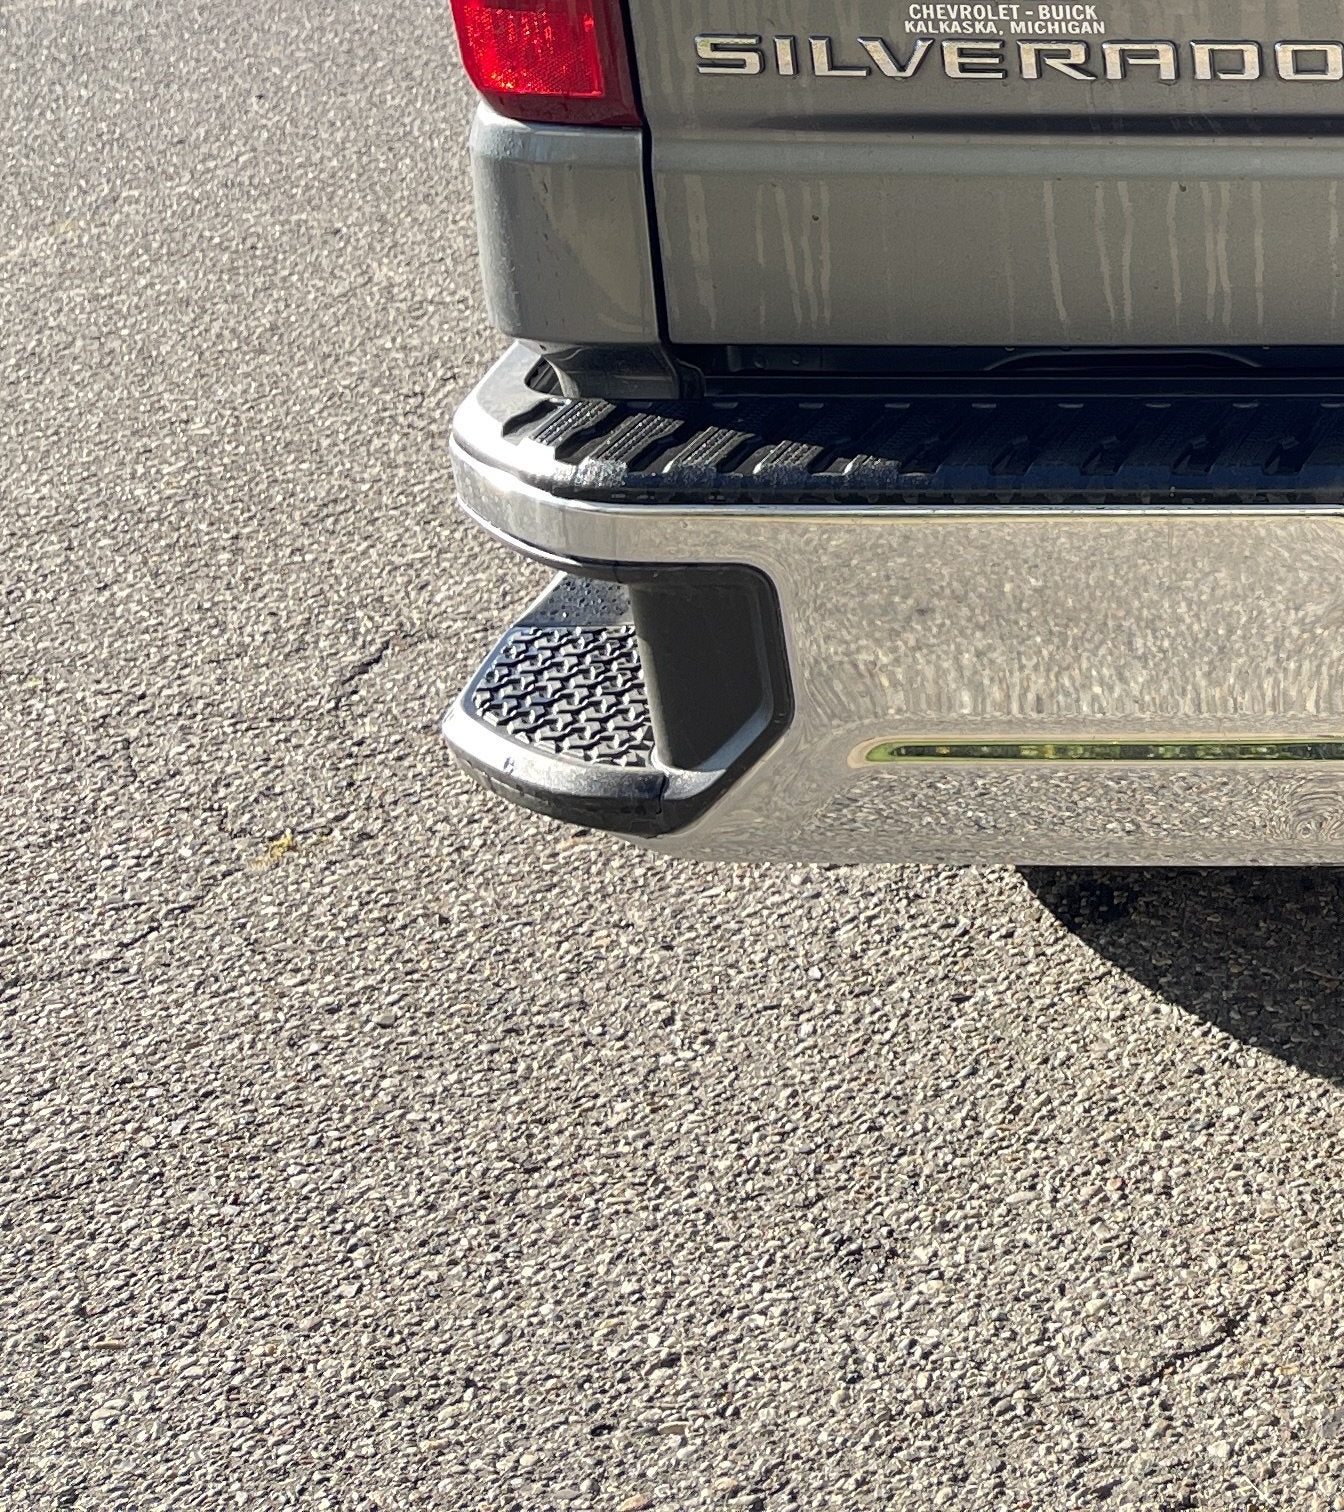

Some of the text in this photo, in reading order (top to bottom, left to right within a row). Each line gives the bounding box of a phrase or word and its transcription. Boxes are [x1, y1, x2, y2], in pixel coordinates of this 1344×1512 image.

[908, 4, 1020, 20] CHEVROLET
[1038, 5, 1098, 20] BUICK
[904, 20, 1106, 36] KALKASKA, MICHIGAN
